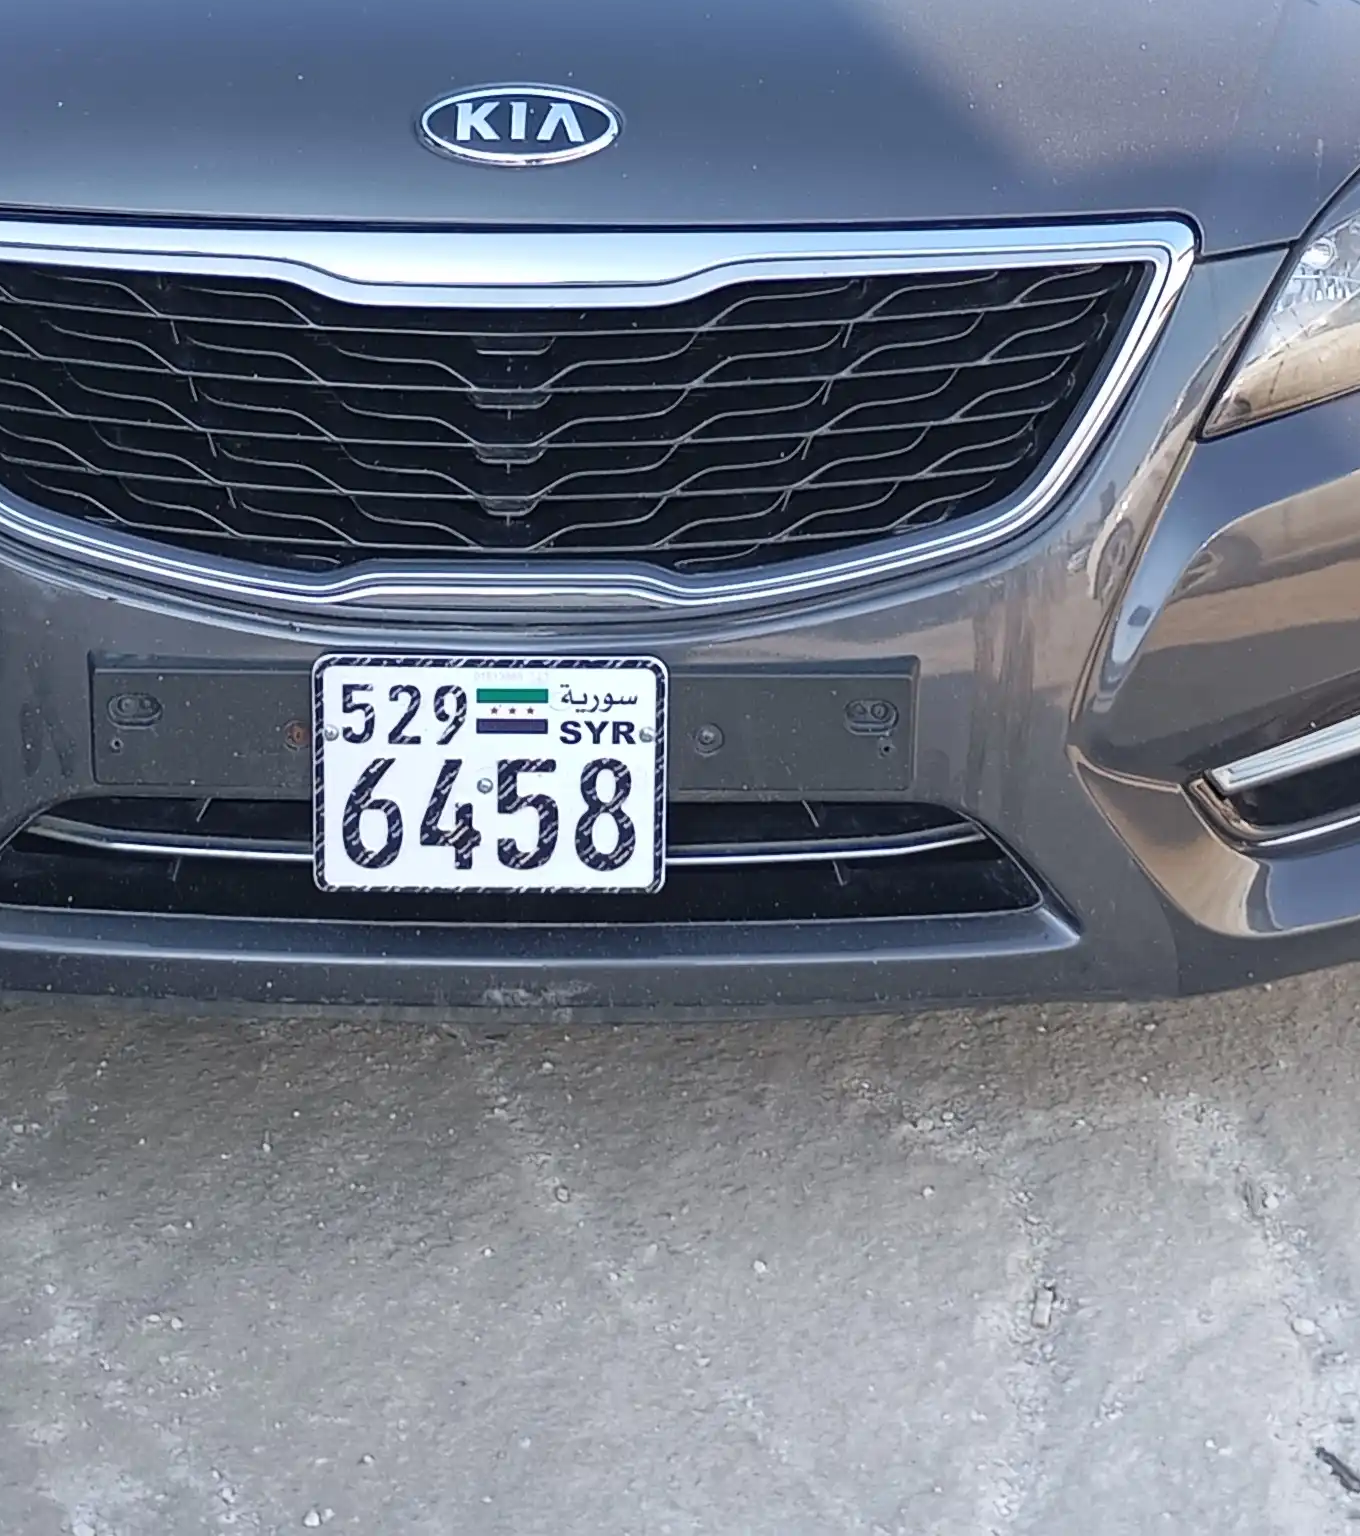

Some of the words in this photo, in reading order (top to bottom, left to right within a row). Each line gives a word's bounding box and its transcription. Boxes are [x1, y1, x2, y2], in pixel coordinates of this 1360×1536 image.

[456, 102, 584, 142] KIA
[342, 684, 467, 745] 529
[560, 684, 638, 713] سورية
[560, 720, 636, 745] SYR
[342, 758, 636, 870] 6458
